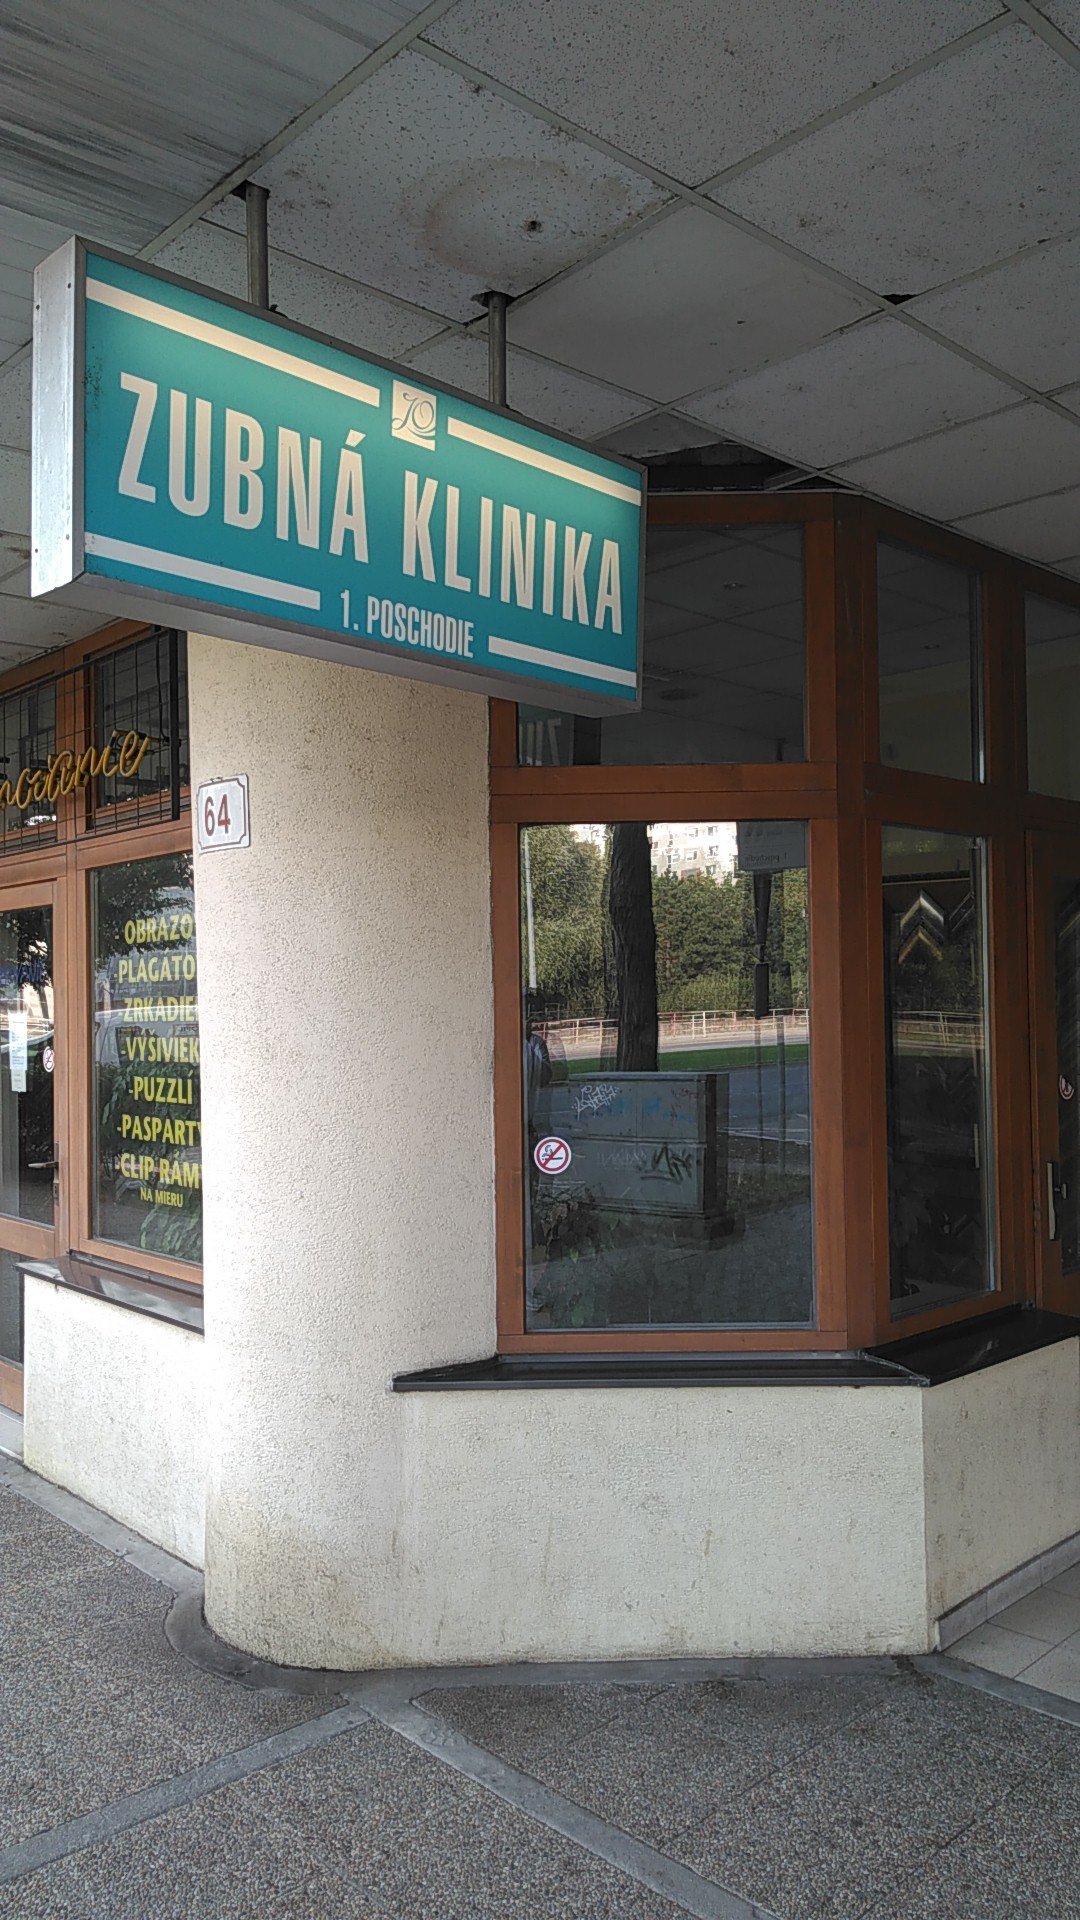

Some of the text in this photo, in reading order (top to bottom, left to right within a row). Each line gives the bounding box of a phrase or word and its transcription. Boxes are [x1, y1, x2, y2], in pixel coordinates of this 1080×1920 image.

[118, 371, 624, 635] ZUBNÁ KLINIKA
[340, 589, 474, 659] 1. POSCHODIE
[204, 794, 231, 837] 64
[124, 913, 196, 945] OBRAZO
[114, 947, 197, 984] -PLAGÁTO
[159, 1151, 203, 1189] RÁM
[140, 1186, 184, 1208] NA MIERU
